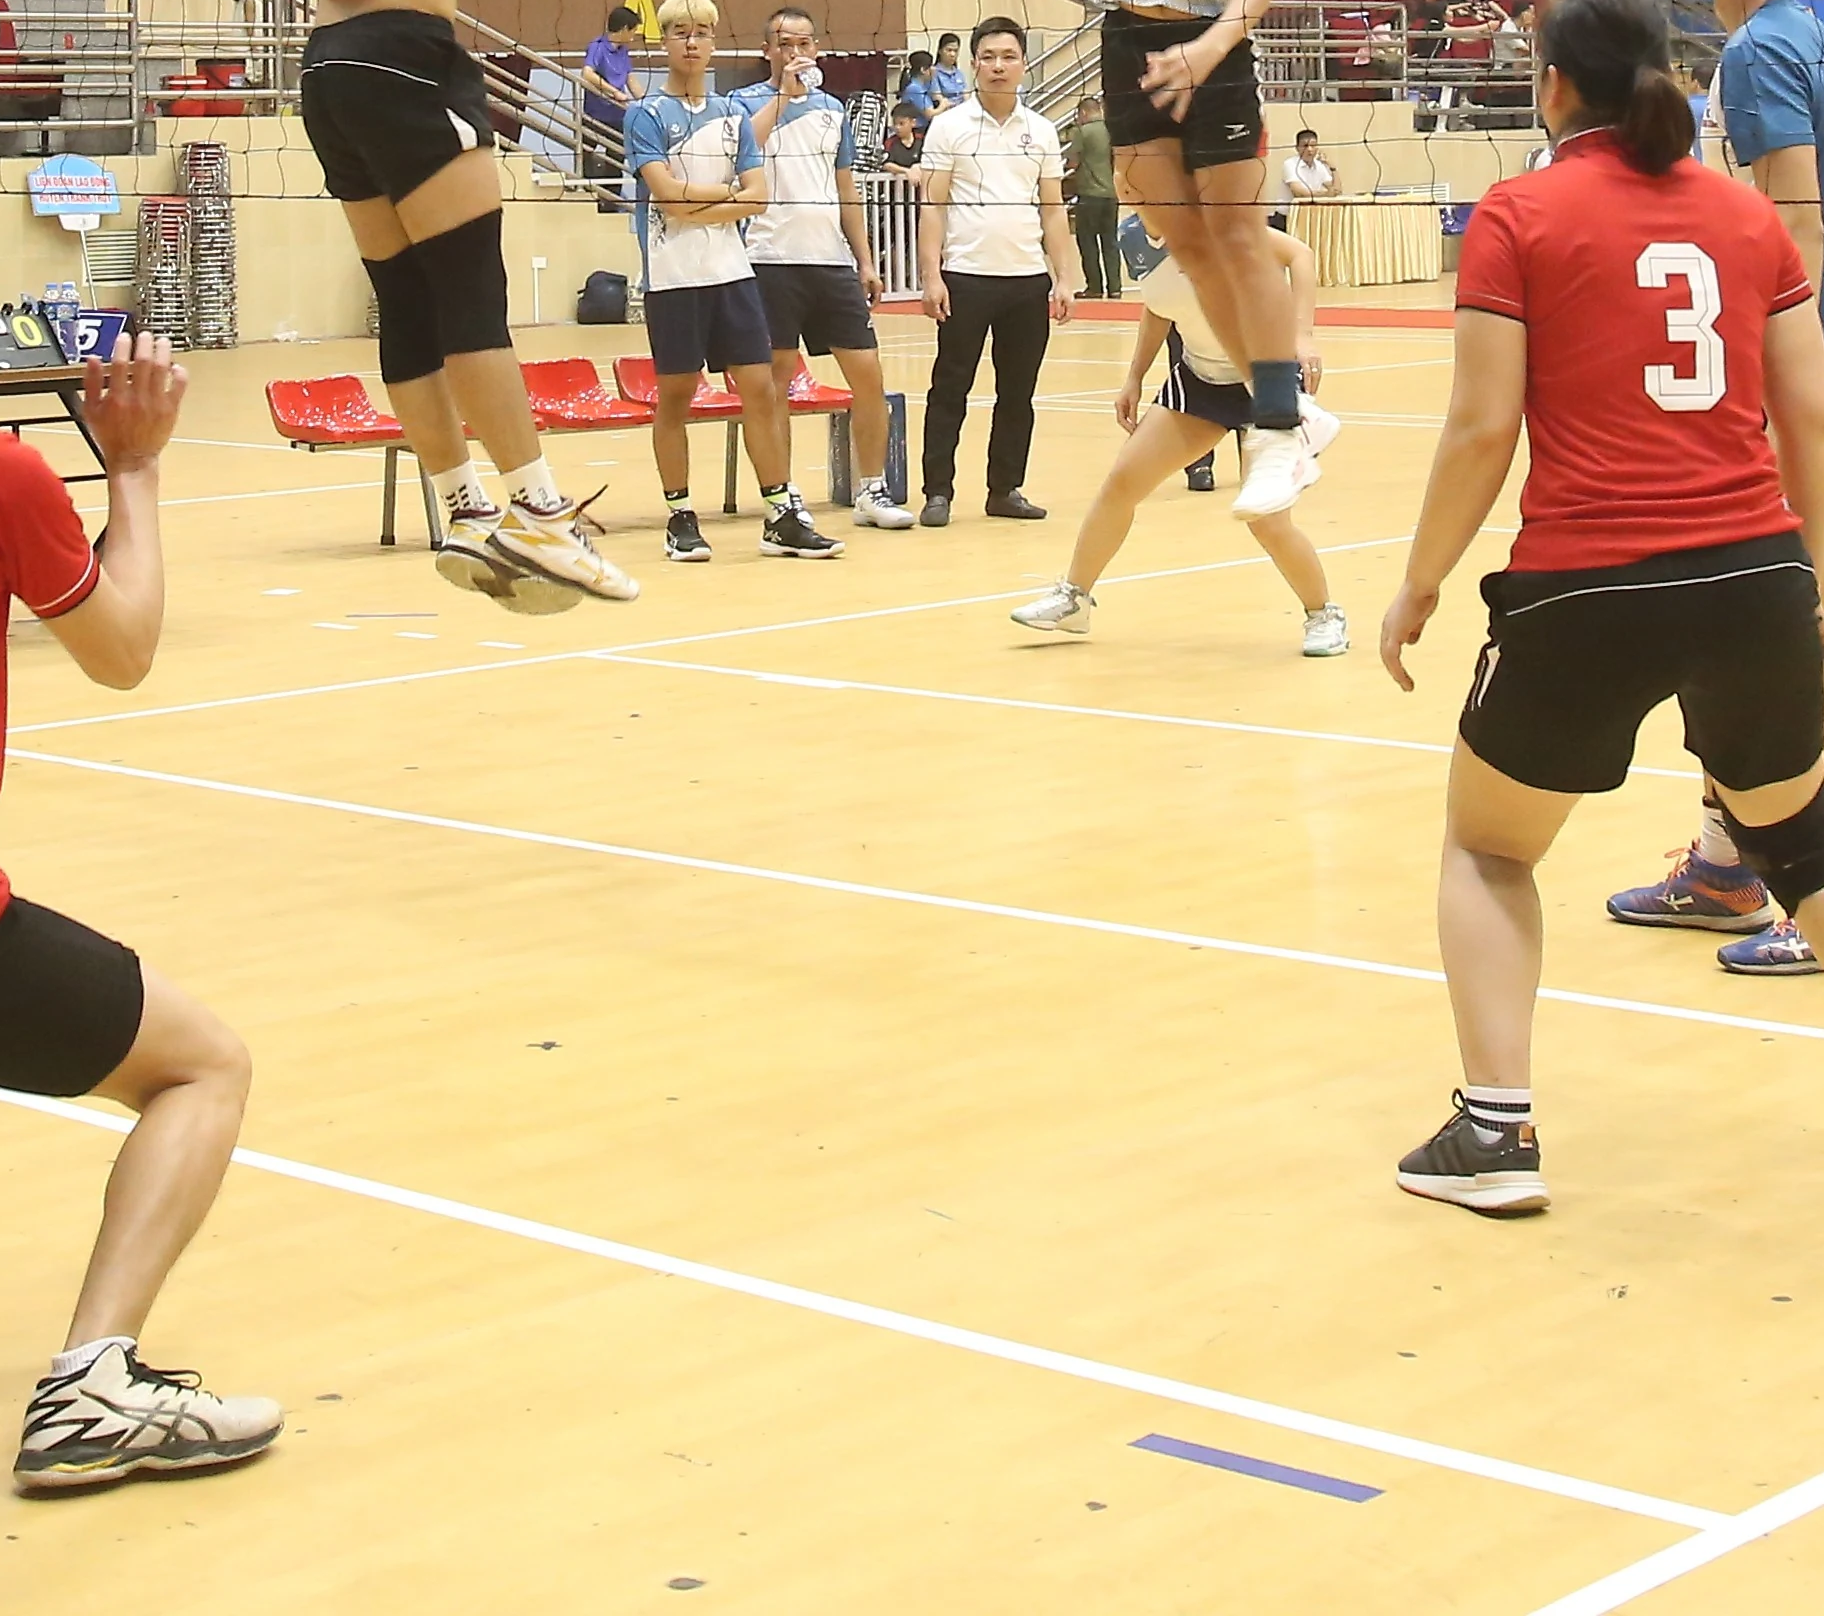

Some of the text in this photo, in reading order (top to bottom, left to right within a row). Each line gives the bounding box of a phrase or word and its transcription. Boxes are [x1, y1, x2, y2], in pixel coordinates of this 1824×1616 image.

[11, 314, 43, 347] 0
[78, 319, 102, 352] 5
[1634, 241, 1728, 412] 3
